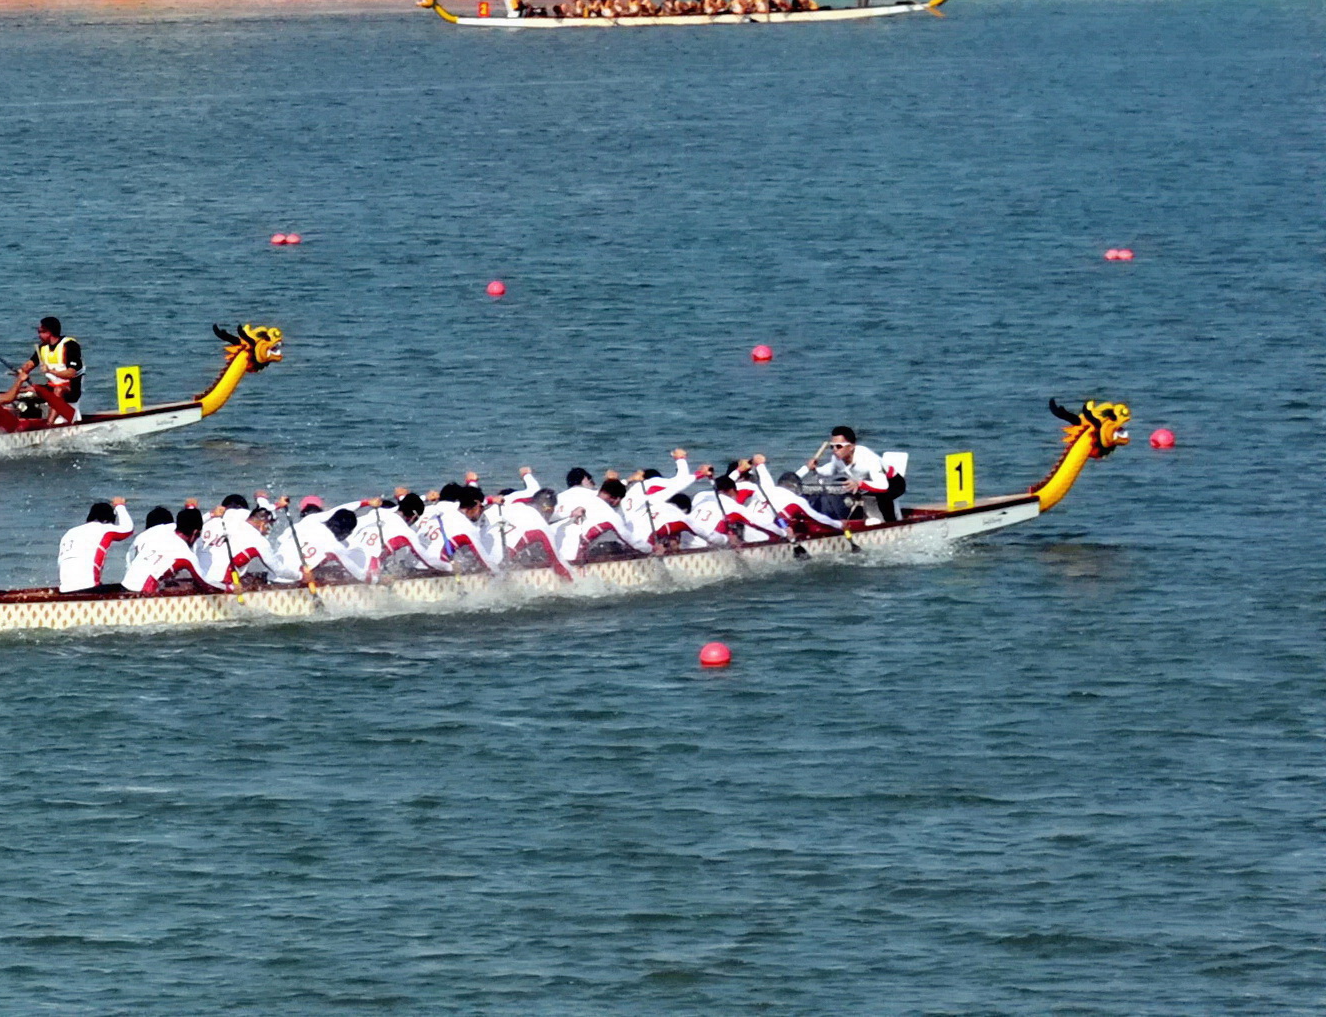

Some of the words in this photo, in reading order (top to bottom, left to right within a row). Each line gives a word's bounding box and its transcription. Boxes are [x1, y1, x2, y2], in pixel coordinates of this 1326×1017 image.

[123, 373, 135, 399] 2
[955, 461, 963, 491] 1
[695, 508, 712, 522] 13
[360, 531, 379, 546] 18
